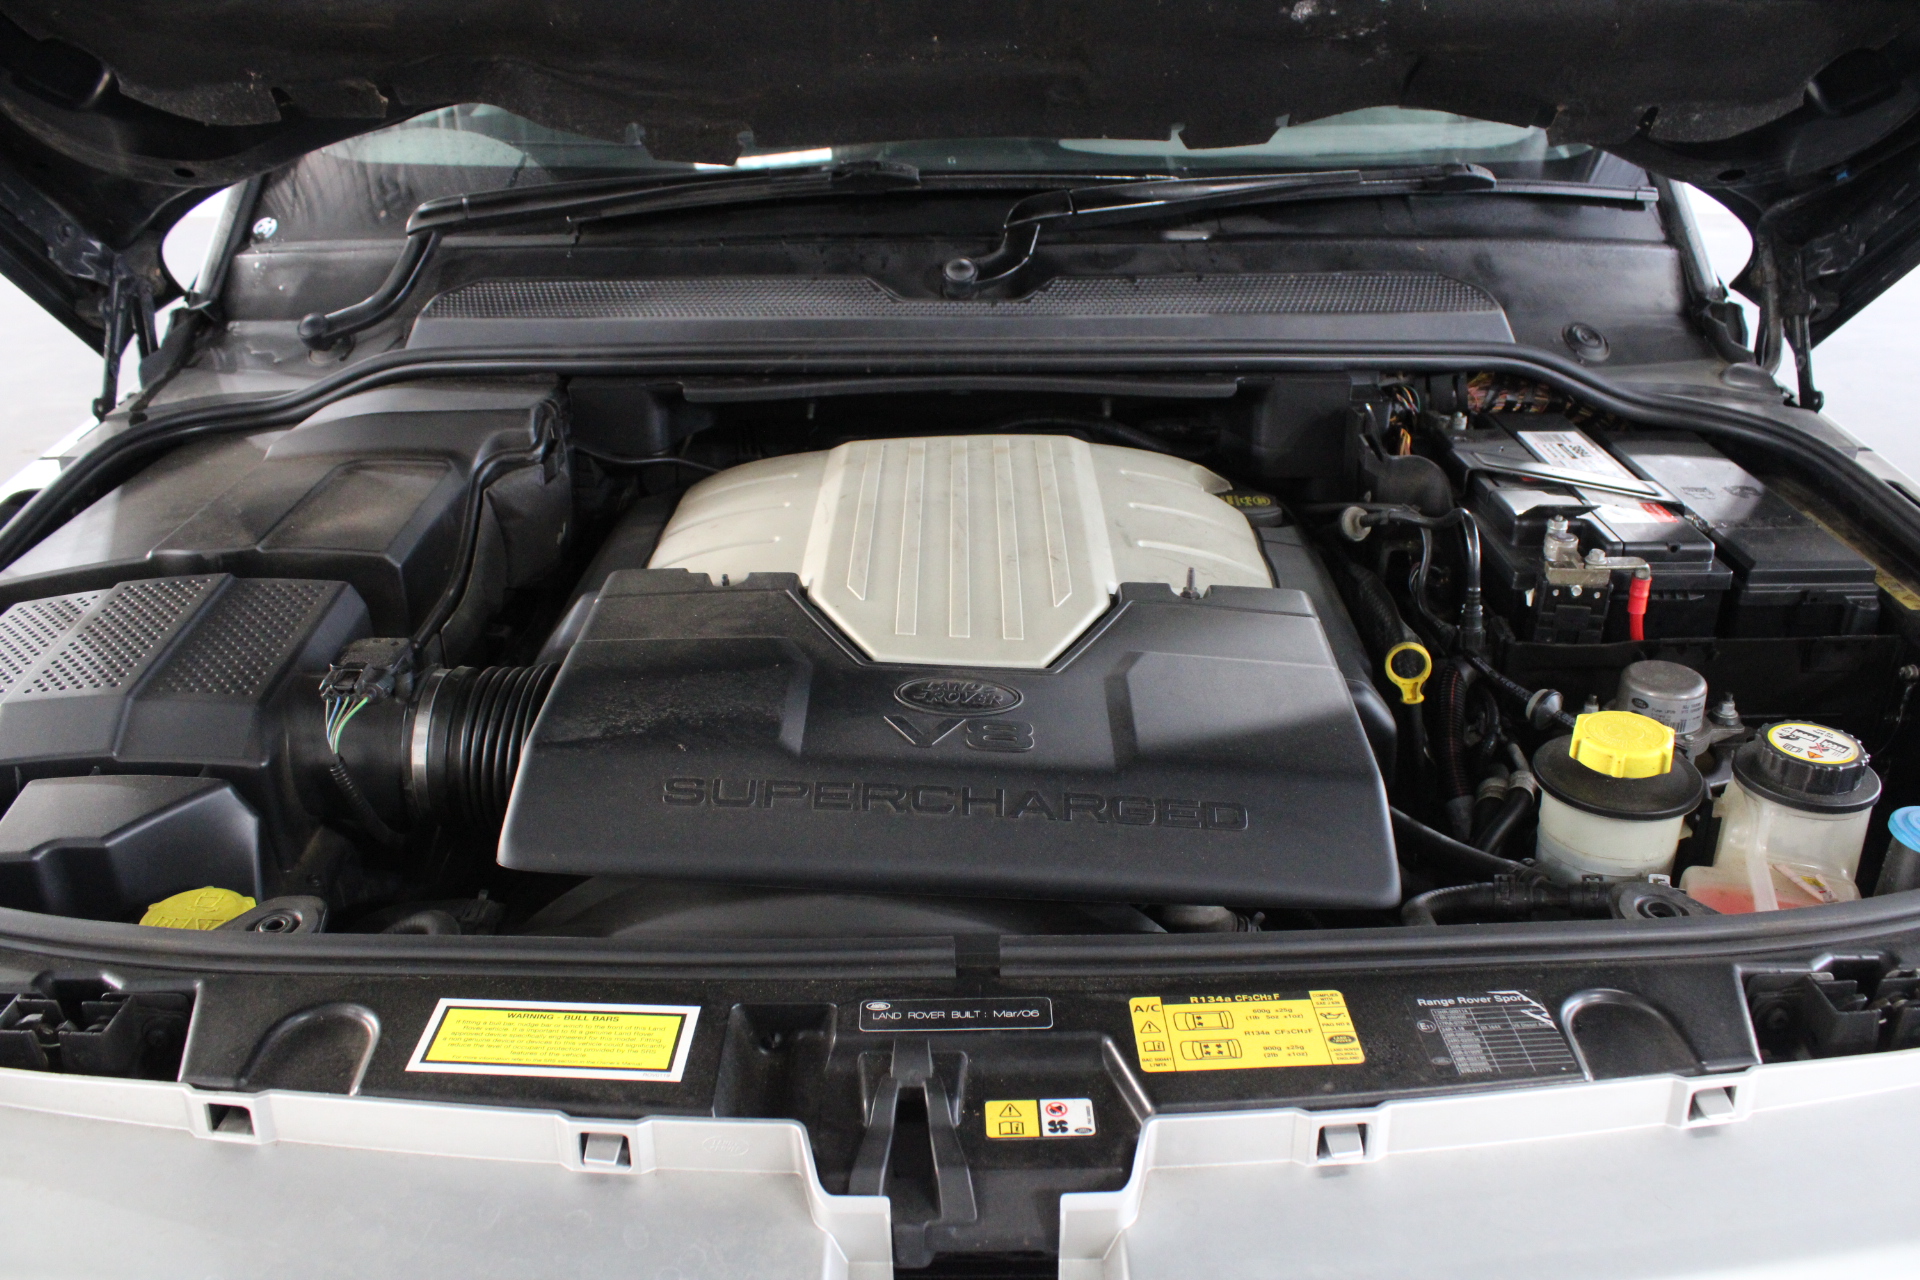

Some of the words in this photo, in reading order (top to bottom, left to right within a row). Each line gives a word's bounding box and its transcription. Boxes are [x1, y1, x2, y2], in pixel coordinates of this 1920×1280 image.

[921, 680, 984, 692] LAND
[926, 691, 1005, 706] ROVER
[883, 714, 1036, 753] V8
[662, 776, 1250, 832] SUPERCHARGED
[1190, 996, 1232, 1004] R134a
[1417, 998, 1456, 1007] Range
[1456, 996, 1492, 1004] Rover
[1134, 1004, 1161, 1013] A/C
[873, 1012, 902, 1020] LAND
[993, 1010, 1040, 1018] Mar/06
